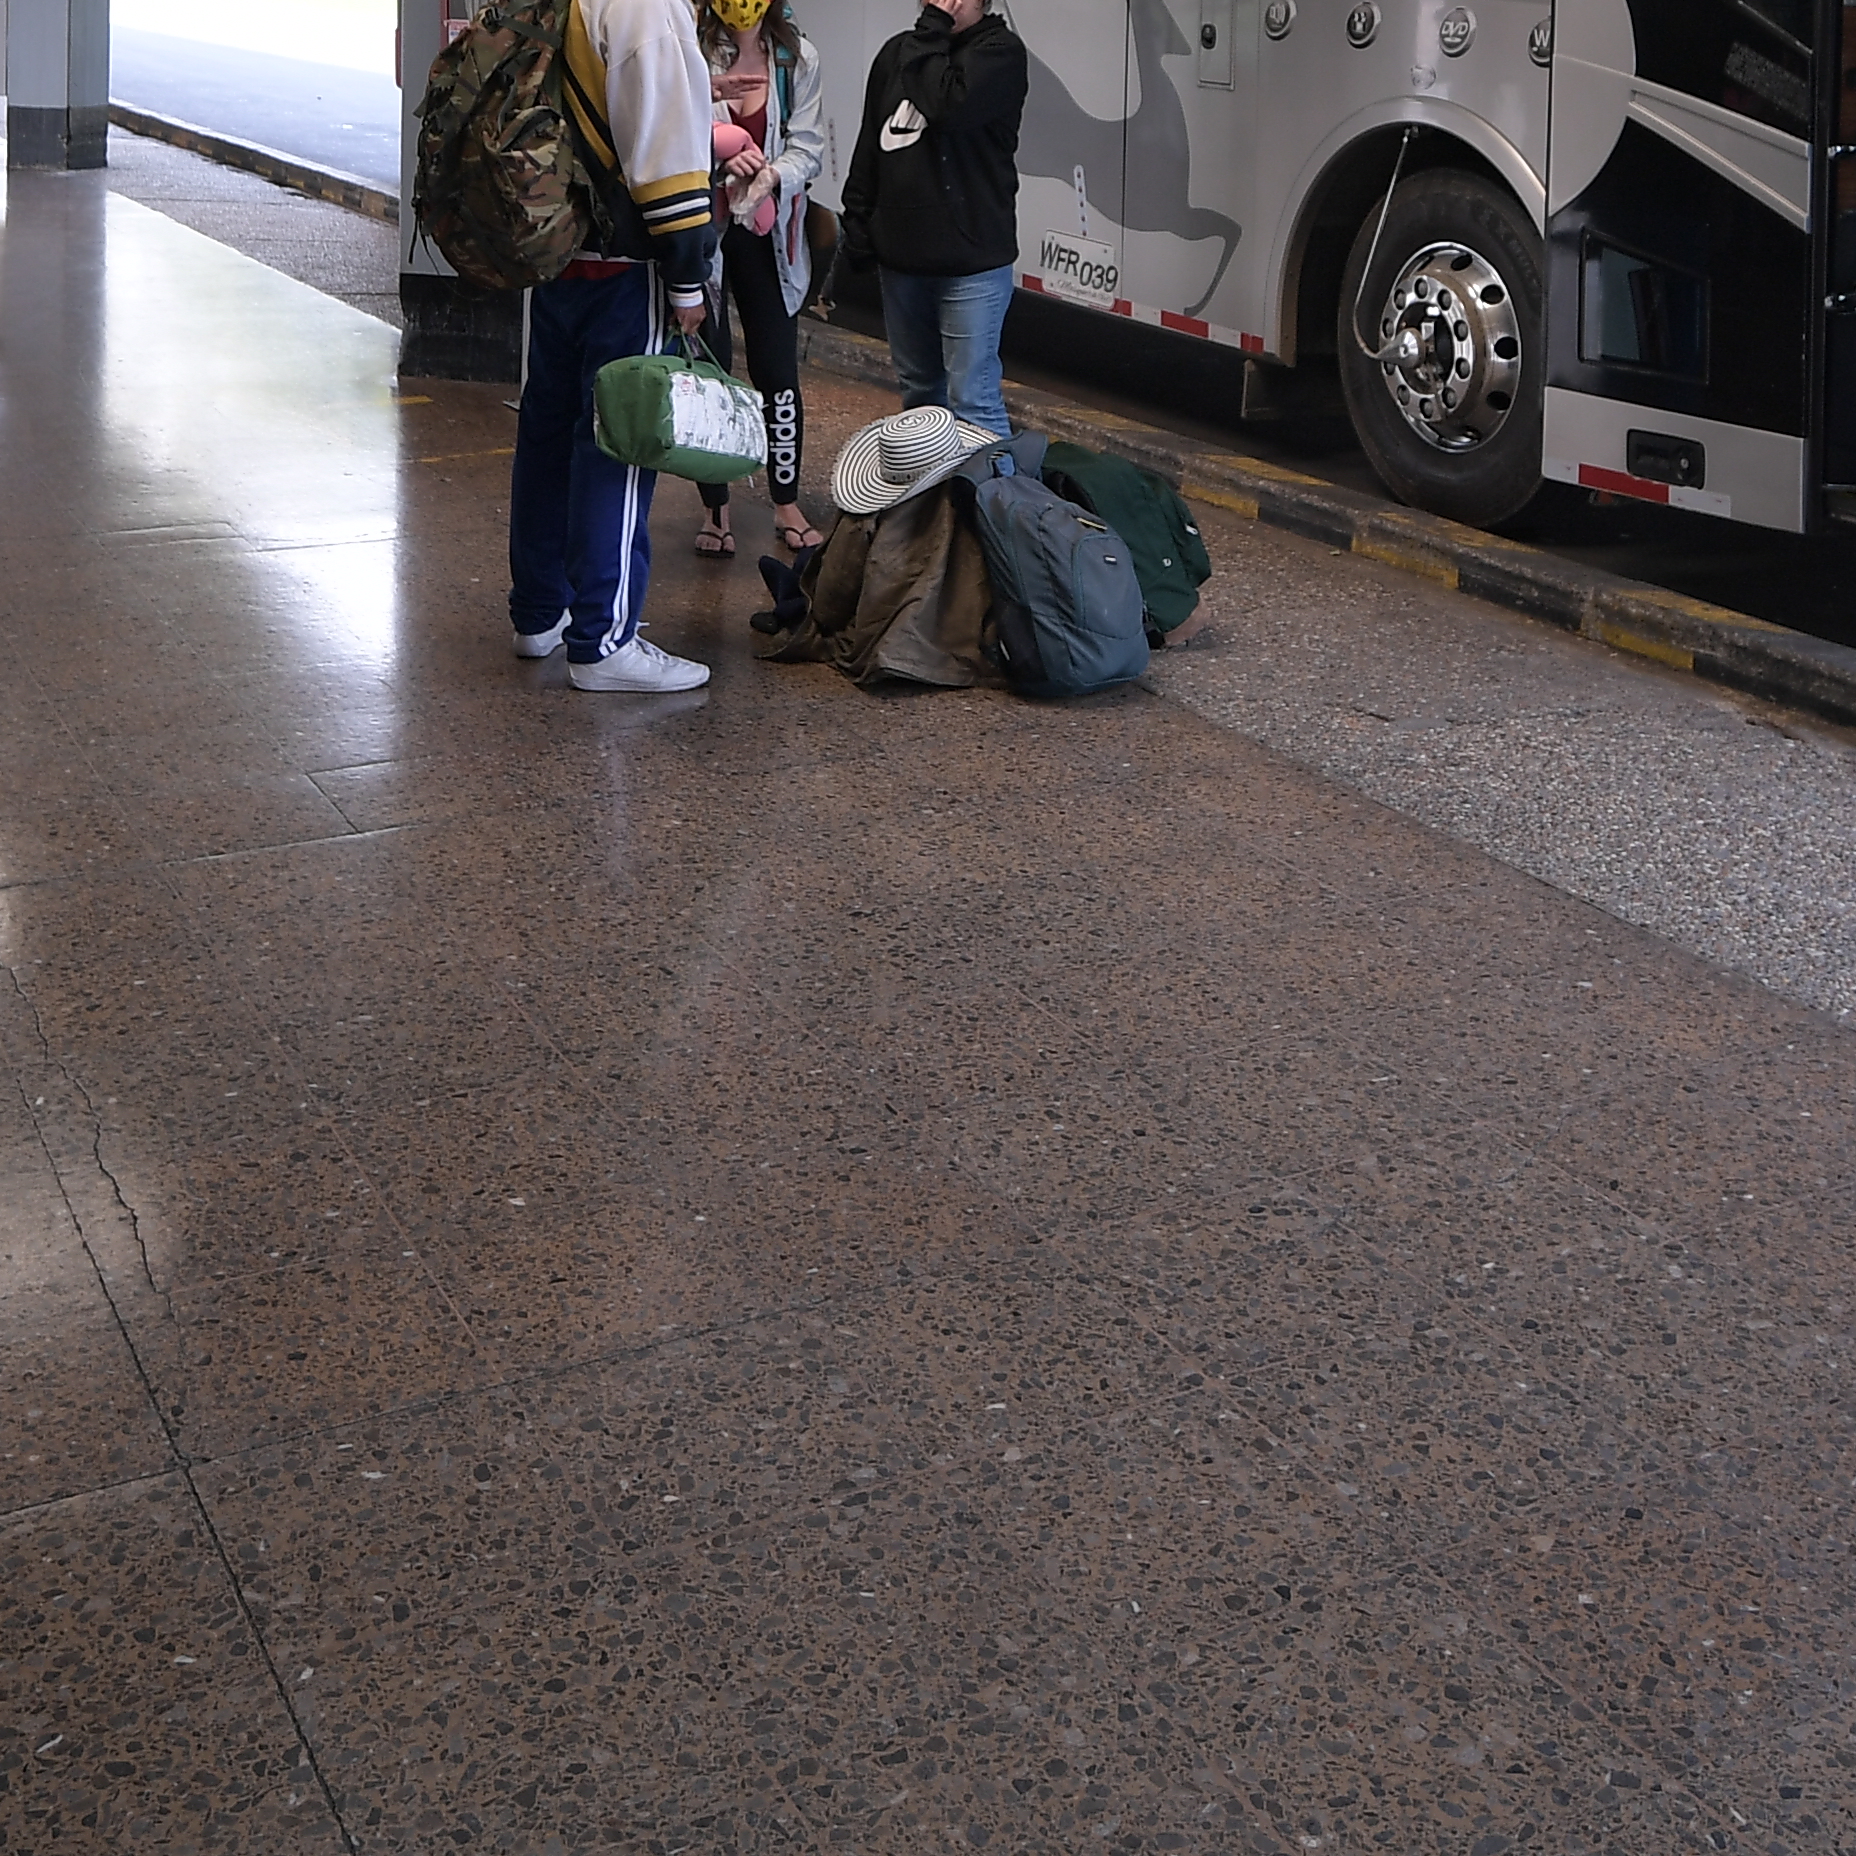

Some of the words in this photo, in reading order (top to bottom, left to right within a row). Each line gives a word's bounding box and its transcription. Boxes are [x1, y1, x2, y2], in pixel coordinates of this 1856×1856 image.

[1441, 20, 1469, 36] DVD
[1533, 28, 1551, 48] W
[769, 388, 797, 485] adidas
